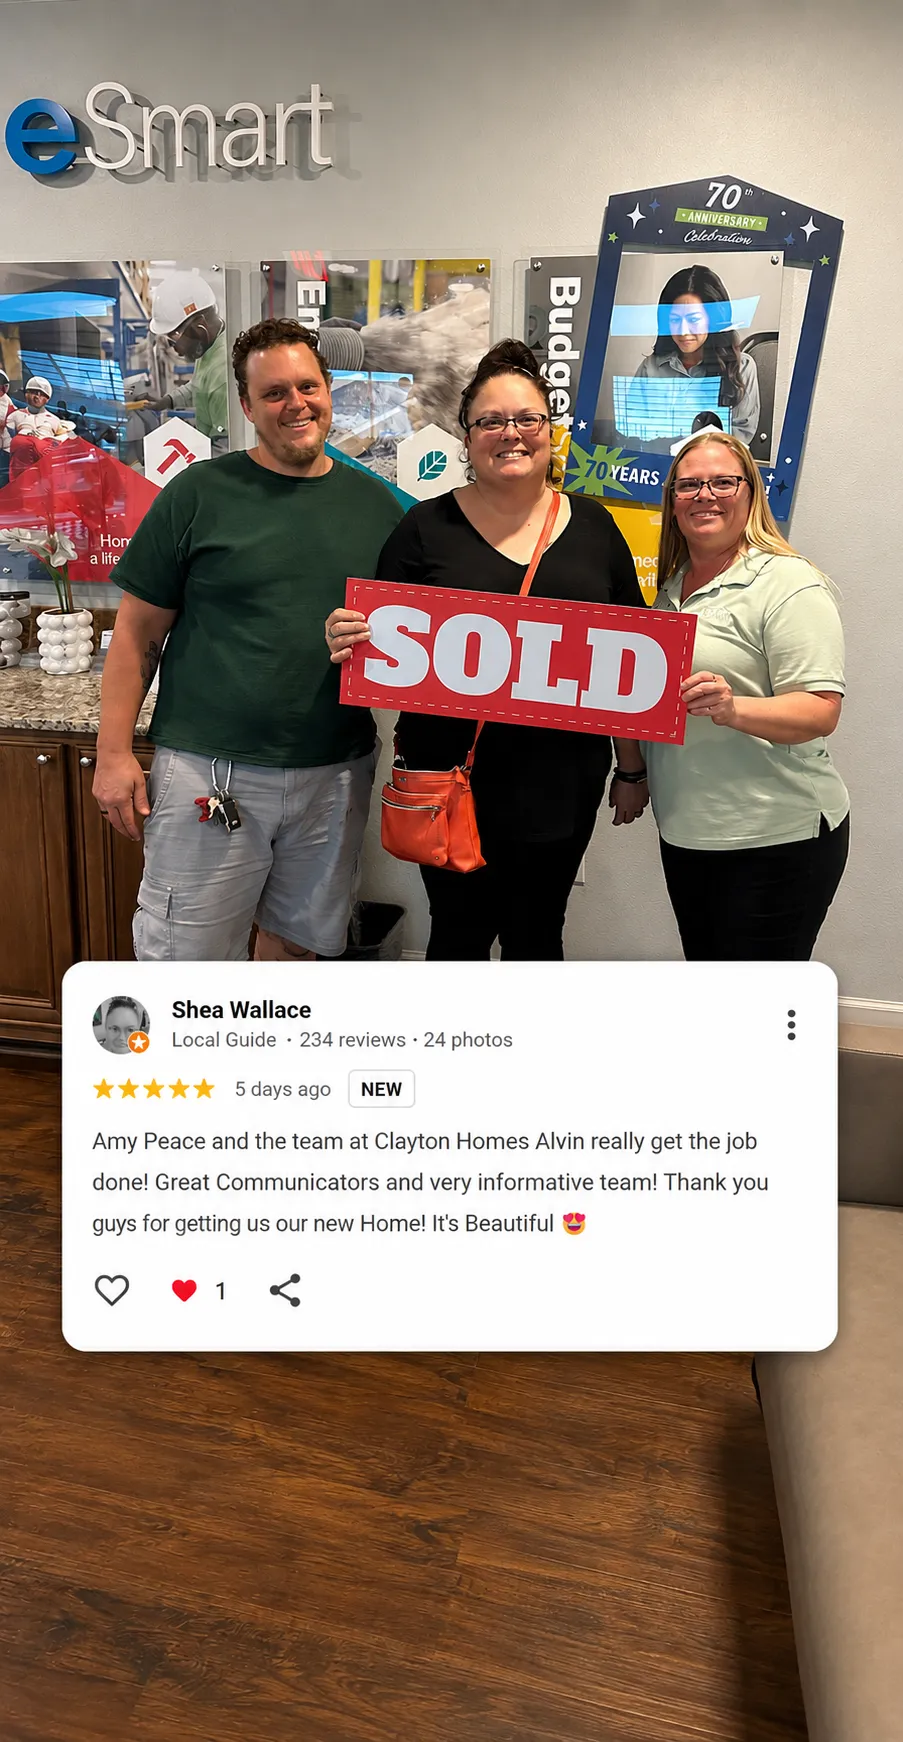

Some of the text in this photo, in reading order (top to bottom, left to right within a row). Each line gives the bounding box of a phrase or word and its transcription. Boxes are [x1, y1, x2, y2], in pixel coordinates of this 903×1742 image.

[5, 81, 334, 174] eSmart
[688, 211, 757, 229] ANNIVERSARY
[683, 228, 753, 245] Celebration
[584, 459, 660, 486] 70 YEARS
[100, 533, 132, 548] Hom
[90, 551, 121, 565] a life
[364, 605, 668, 714] SOLD
